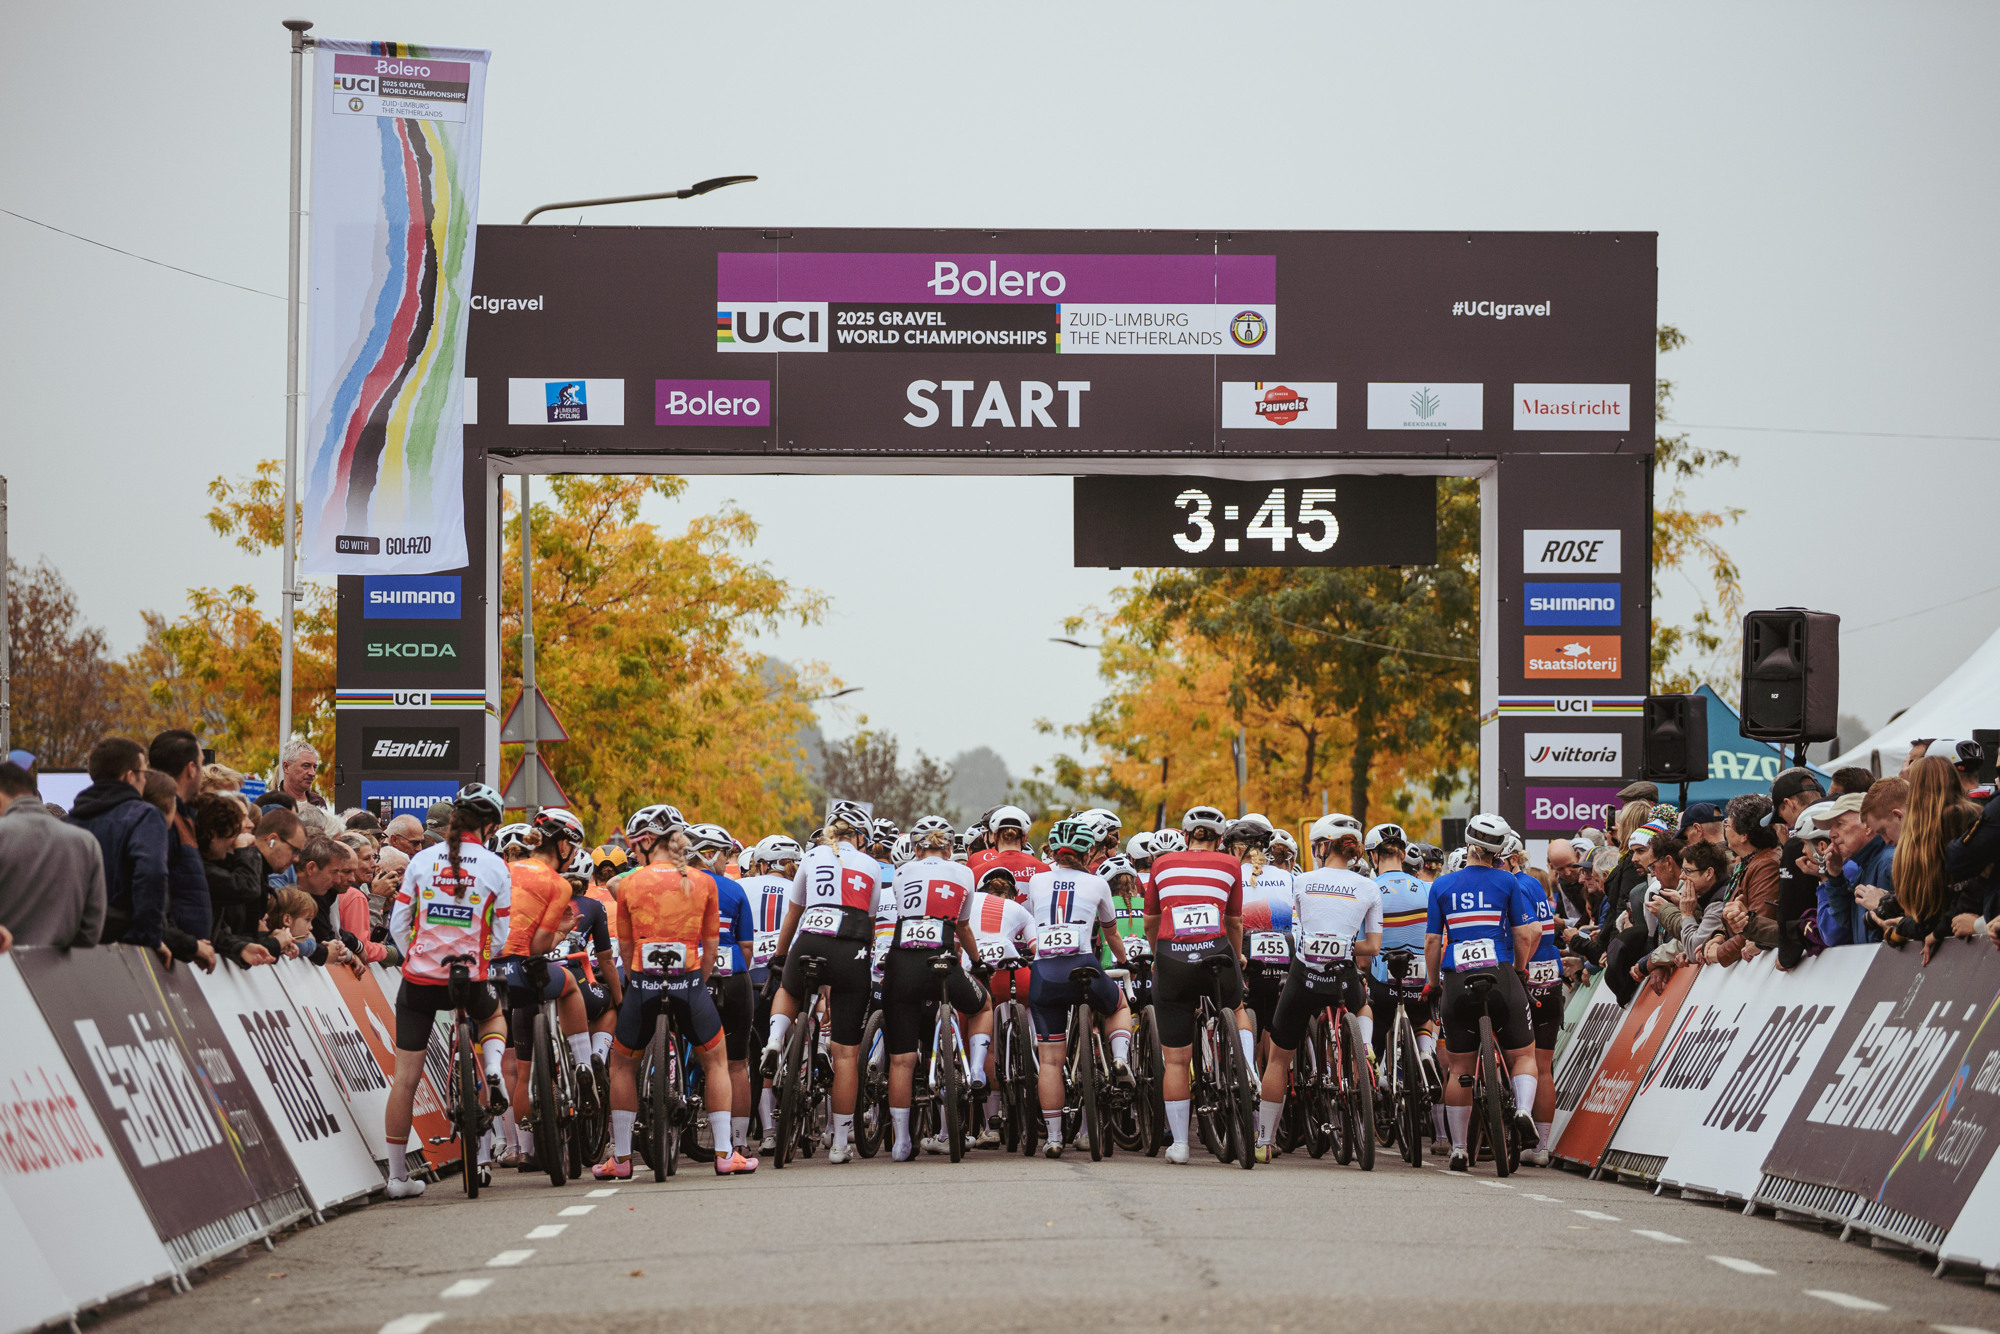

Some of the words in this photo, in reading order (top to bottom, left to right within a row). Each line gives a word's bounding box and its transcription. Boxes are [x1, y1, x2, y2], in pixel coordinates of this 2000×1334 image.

[375, 60, 430, 77] Bolero
[342, 78, 375, 92] UCI
[408, 90, 466, 99] CHAMPIONSHIPS
[382, 100, 429, 109] ZUID-LIMBURG
[396, 108, 443, 117] NETHERLANDS
[927, 260, 1066, 296] Bolero
[470, 295, 544, 315] CIgravel
[1452, 300, 1551, 320] #UCIgravel
[837, 312, 875, 326] 2025
[878, 311, 946, 326] GRAVEL
[1069, 312, 1189, 327] ZUID-LIMBURG
[736, 311, 819, 343] UCI
[837, 330, 900, 344] WORLD
[904, 330, 1047, 345] CHAMPIONSHIPS
[1069, 331, 1100, 345] THE
[1104, 331, 1222, 346] NETHERLANDS
[664, 390, 761, 416] Bolero
[903, 379, 1091, 428] START
[1259, 399, 1305, 413] Pauwels
[1522, 399, 1621, 415] Maastricht
[1172, 488, 1339, 553] 3:45
[339, 539, 350, 550] GO
[350, 540, 369, 551] WITH
[386, 536, 431, 555] GOLAZO
[1540, 540, 1604, 563] ROSE
[370, 590, 456, 604] SHIMANO
[1530, 598, 1615, 611] SHIMANO
[1529, 657, 1617, 672] Staatsloterij
[395, 693, 426, 705] UCI
[1556, 700, 1588, 712] UCI
[371, 739, 451, 757] Santini
[1551, 746, 1617, 762] vittoria
[1708, 750, 1781, 781] AZO
[1011, 867, 1035, 878] ada
[816, 865, 835, 897] SUI
[1053, 880, 1075, 890] GBR
[1305, 883, 1357, 894] GERMANY
[1410, 882, 1418, 893] EY
[763, 885, 784, 894] GBR
[904, 880, 922, 909] SUI
[1380, 885, 1390, 895] EY
[1452, 891, 1492, 911] ISL
[429, 906, 471, 919] ALTEZ
[1116, 909, 1144, 918] ELAN
[1183, 912, 1209, 926] 471
[806, 915, 834, 928] 469
[906, 926, 936, 940] 466
[1044, 932, 1072, 946] 453
[759, 939, 777, 954] 45
[1126, 945, 1144, 957] 67
[1171, 941, 1215, 952] DANMARK
[1257, 941, 1284, 954] 455
[1310, 940, 1340, 955] 470
[1462, 947, 1488, 961] 461
[1307, 972, 1336, 982] GERMA
[1534, 969, 1554, 982] 452
[1659, 1002, 1747, 1091] vittoria
[1702, 1004, 1836, 1132] ROSE
[1805, 1001, 1977, 1136] Santini
[237, 1009, 341, 1143] ROSE
[74, 1012, 224, 1168] Santini
[1581, 1064, 1645, 1126] Staatsloterij
